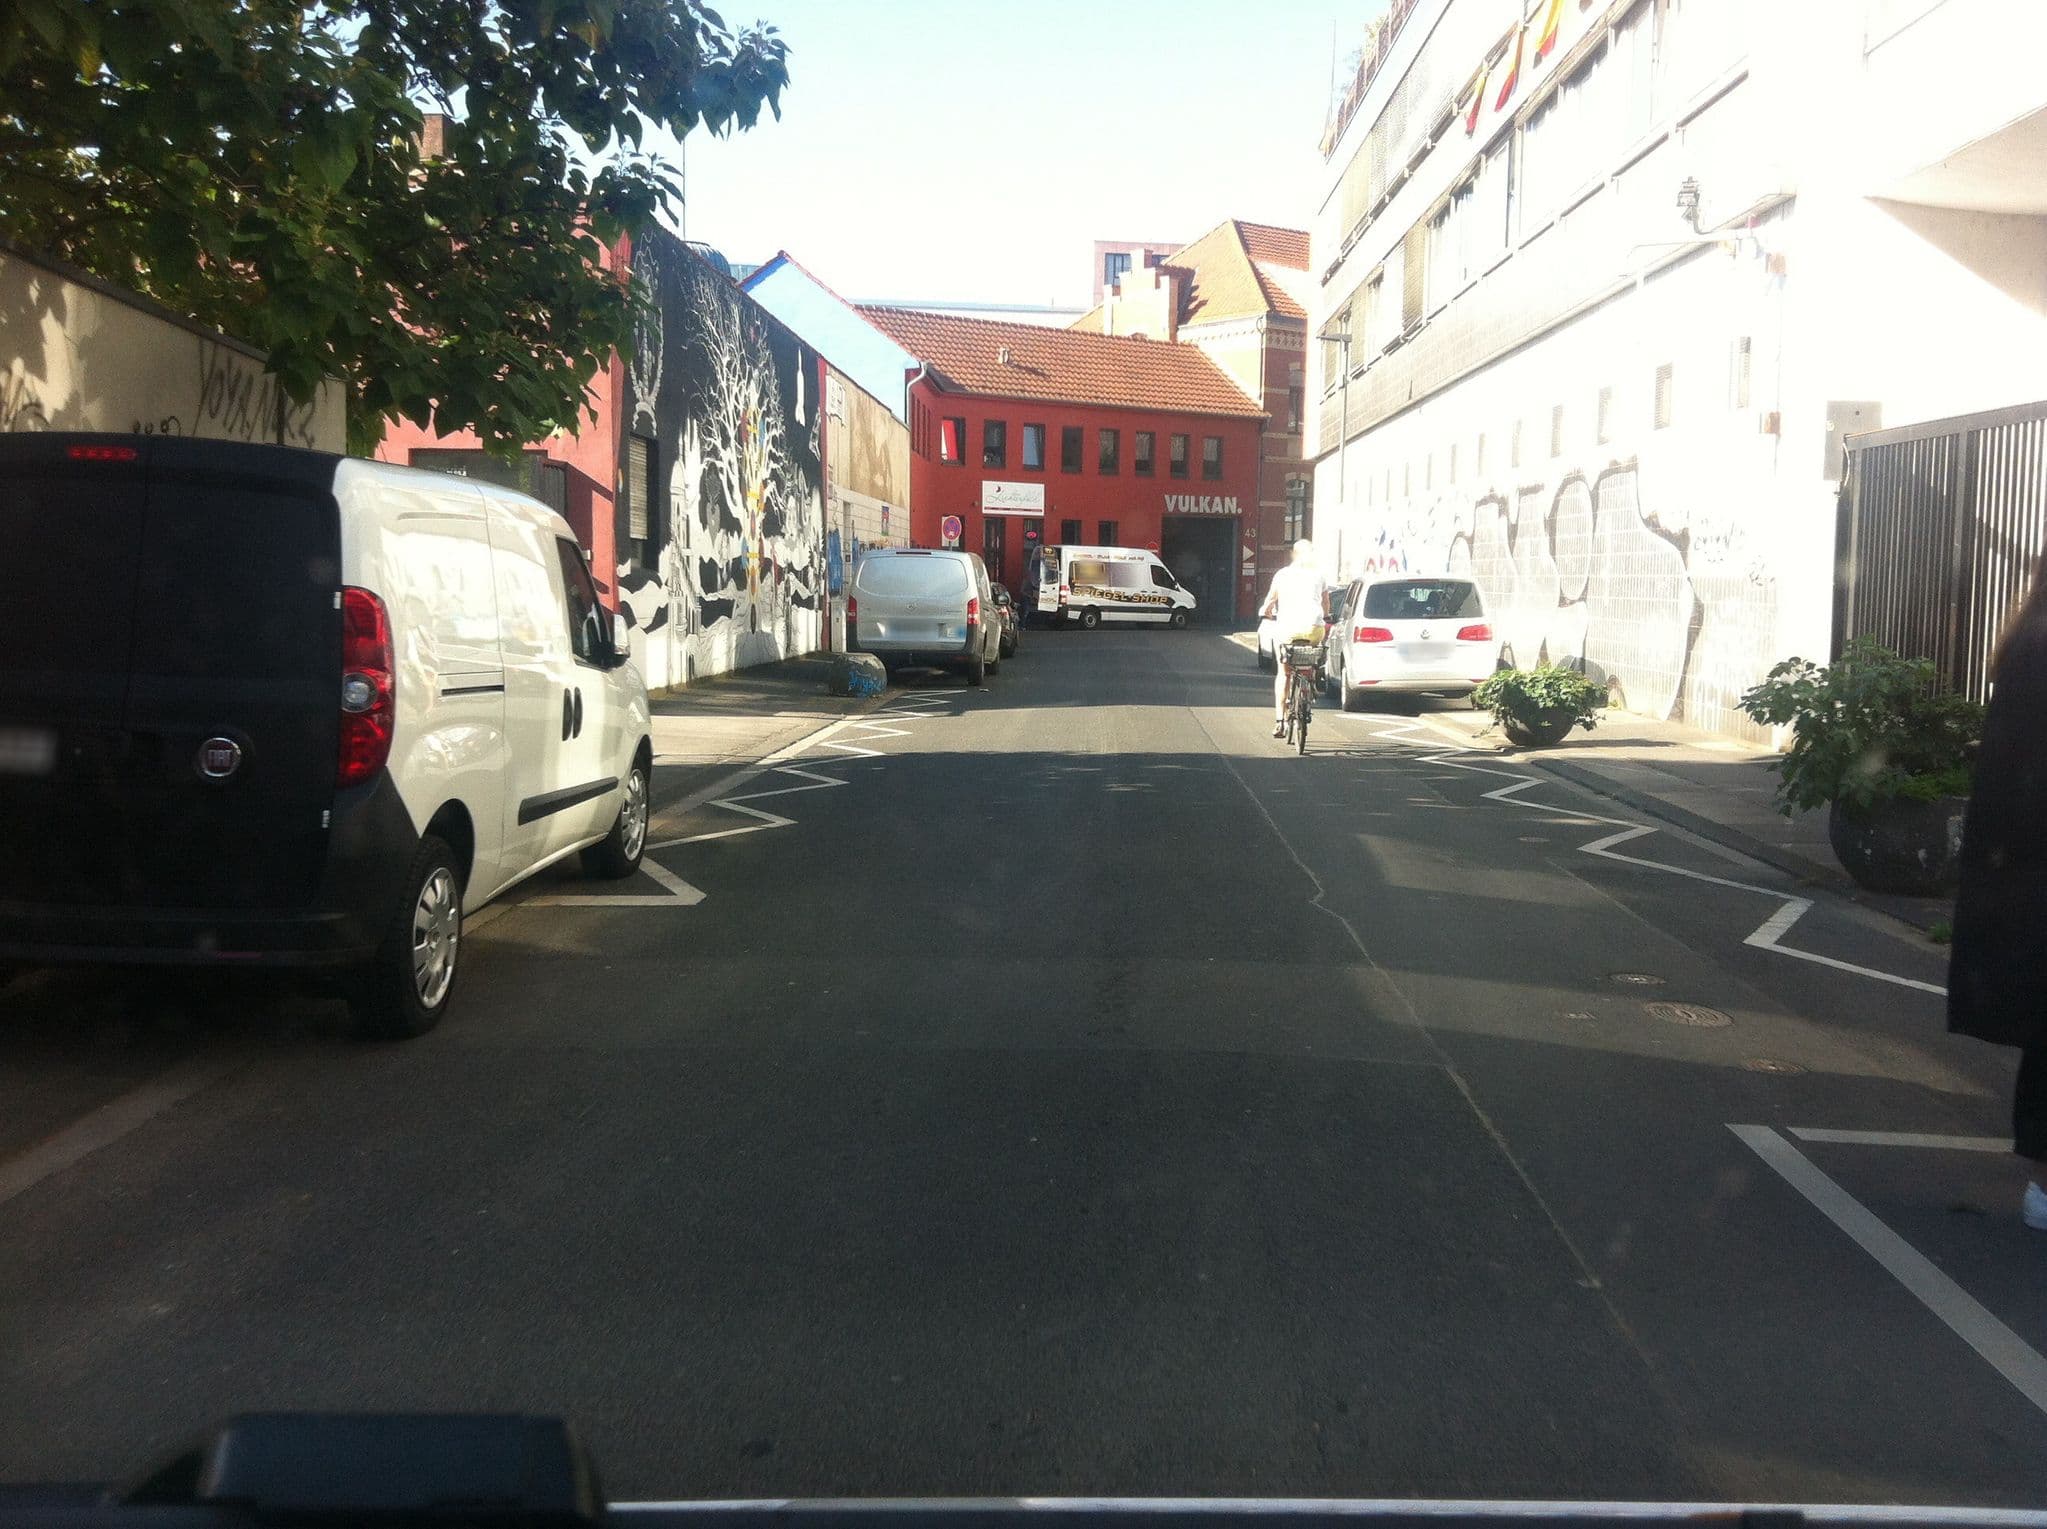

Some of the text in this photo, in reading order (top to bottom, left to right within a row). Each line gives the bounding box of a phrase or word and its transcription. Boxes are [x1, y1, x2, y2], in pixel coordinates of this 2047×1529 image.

[1164, 494, 1243, 514] VULKAN.
[1244, 528, 1257, 538] 43
[1072, 586, 1128, 602] SPIEGEL
[1131, 592, 1169, 605] SHOP
